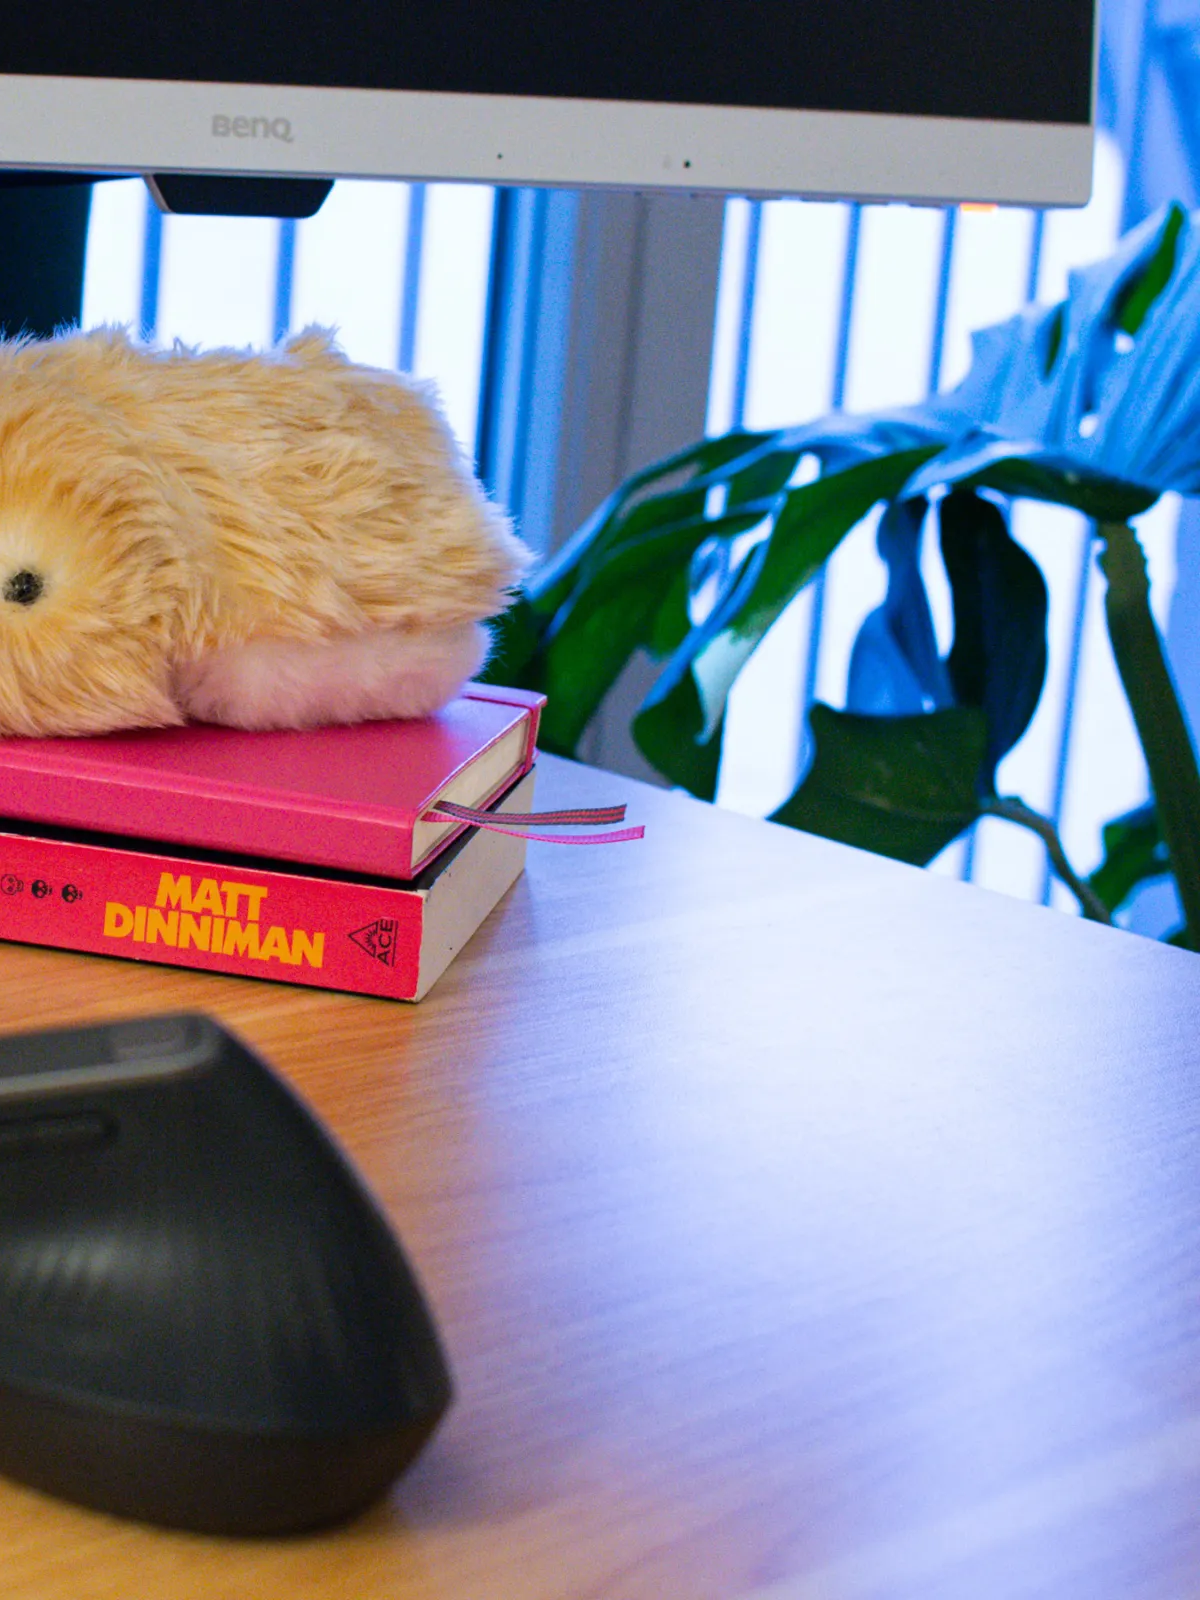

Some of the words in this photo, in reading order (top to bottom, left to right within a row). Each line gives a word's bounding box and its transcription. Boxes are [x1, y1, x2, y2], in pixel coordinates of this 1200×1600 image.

[212, 113, 295, 143] BenQ
[156, 872, 268, 921] MATT
[103, 902, 326, 968] DINNIMAN
[376, 918, 394, 966] ACE
